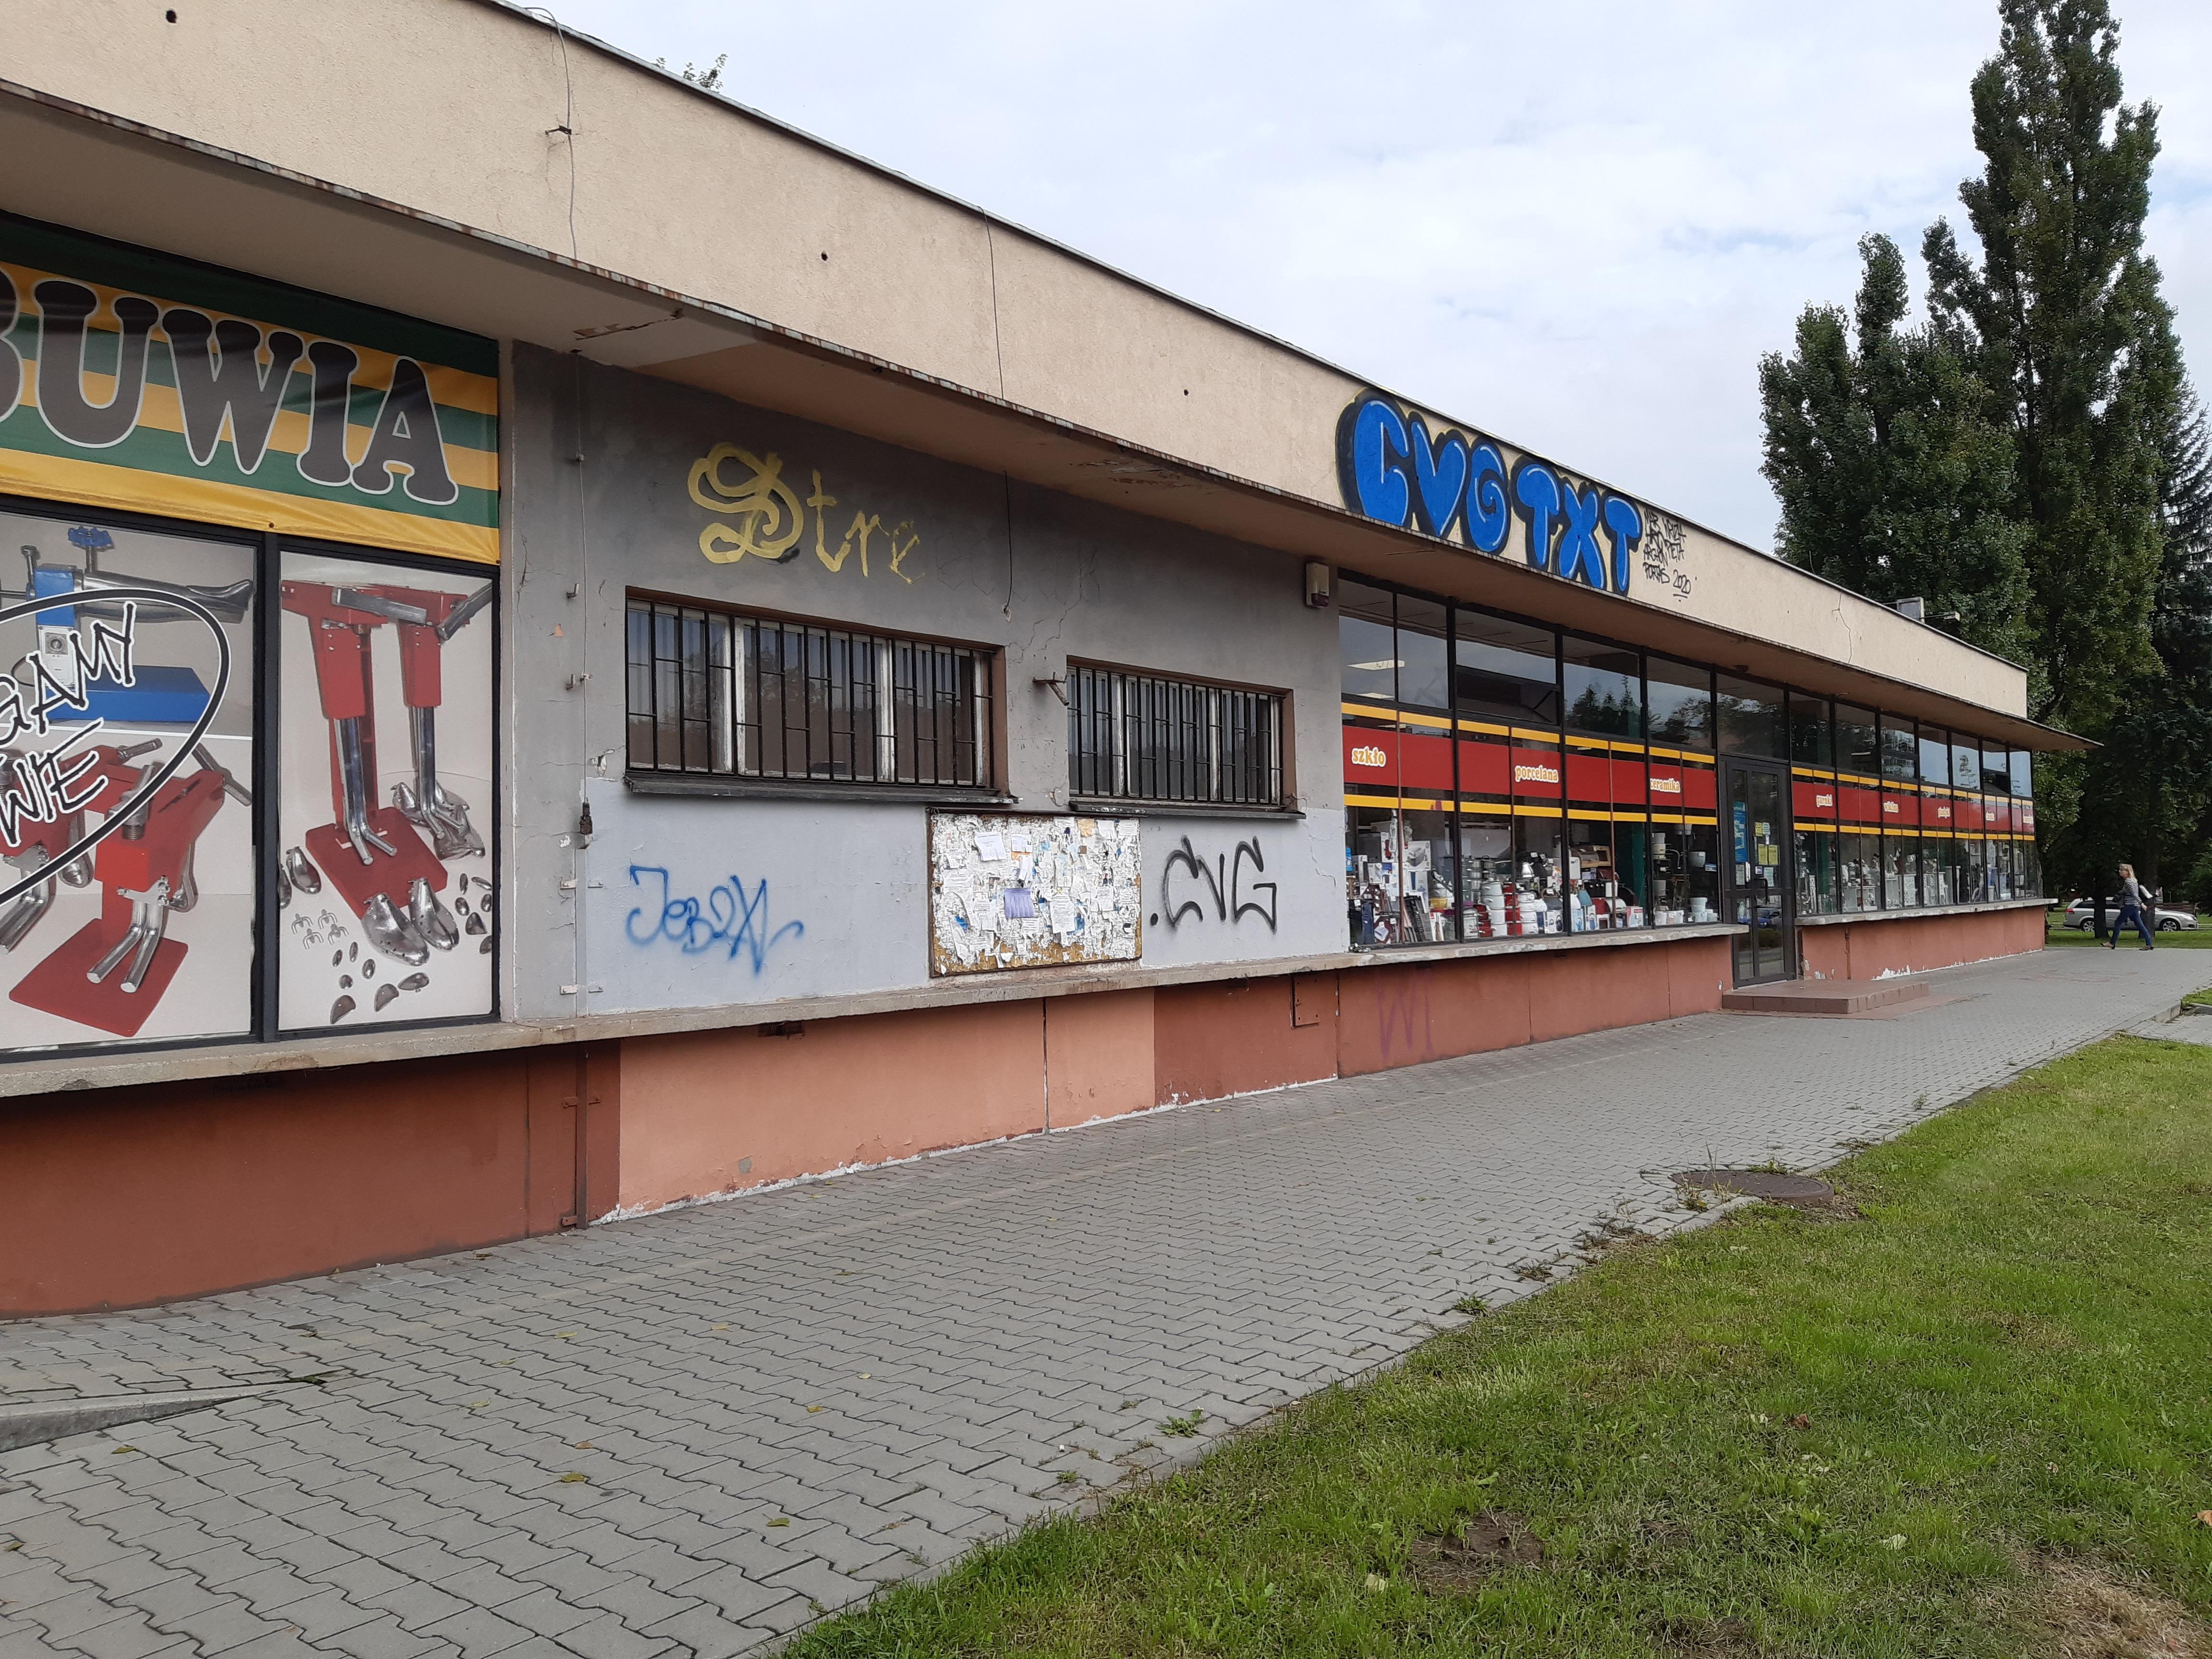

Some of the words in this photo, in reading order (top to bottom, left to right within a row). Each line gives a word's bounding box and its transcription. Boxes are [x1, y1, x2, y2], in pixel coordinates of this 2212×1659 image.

[0, 267, 458, 505] UWIA
[1508, 453, 1643, 596] TXT
[1672, 569, 1692, 595] 2020
[1352, 746, 1386, 767] szkło
[1515, 765, 1558, 782] porcelana
[1650, 778, 1680, 792] ceramika
